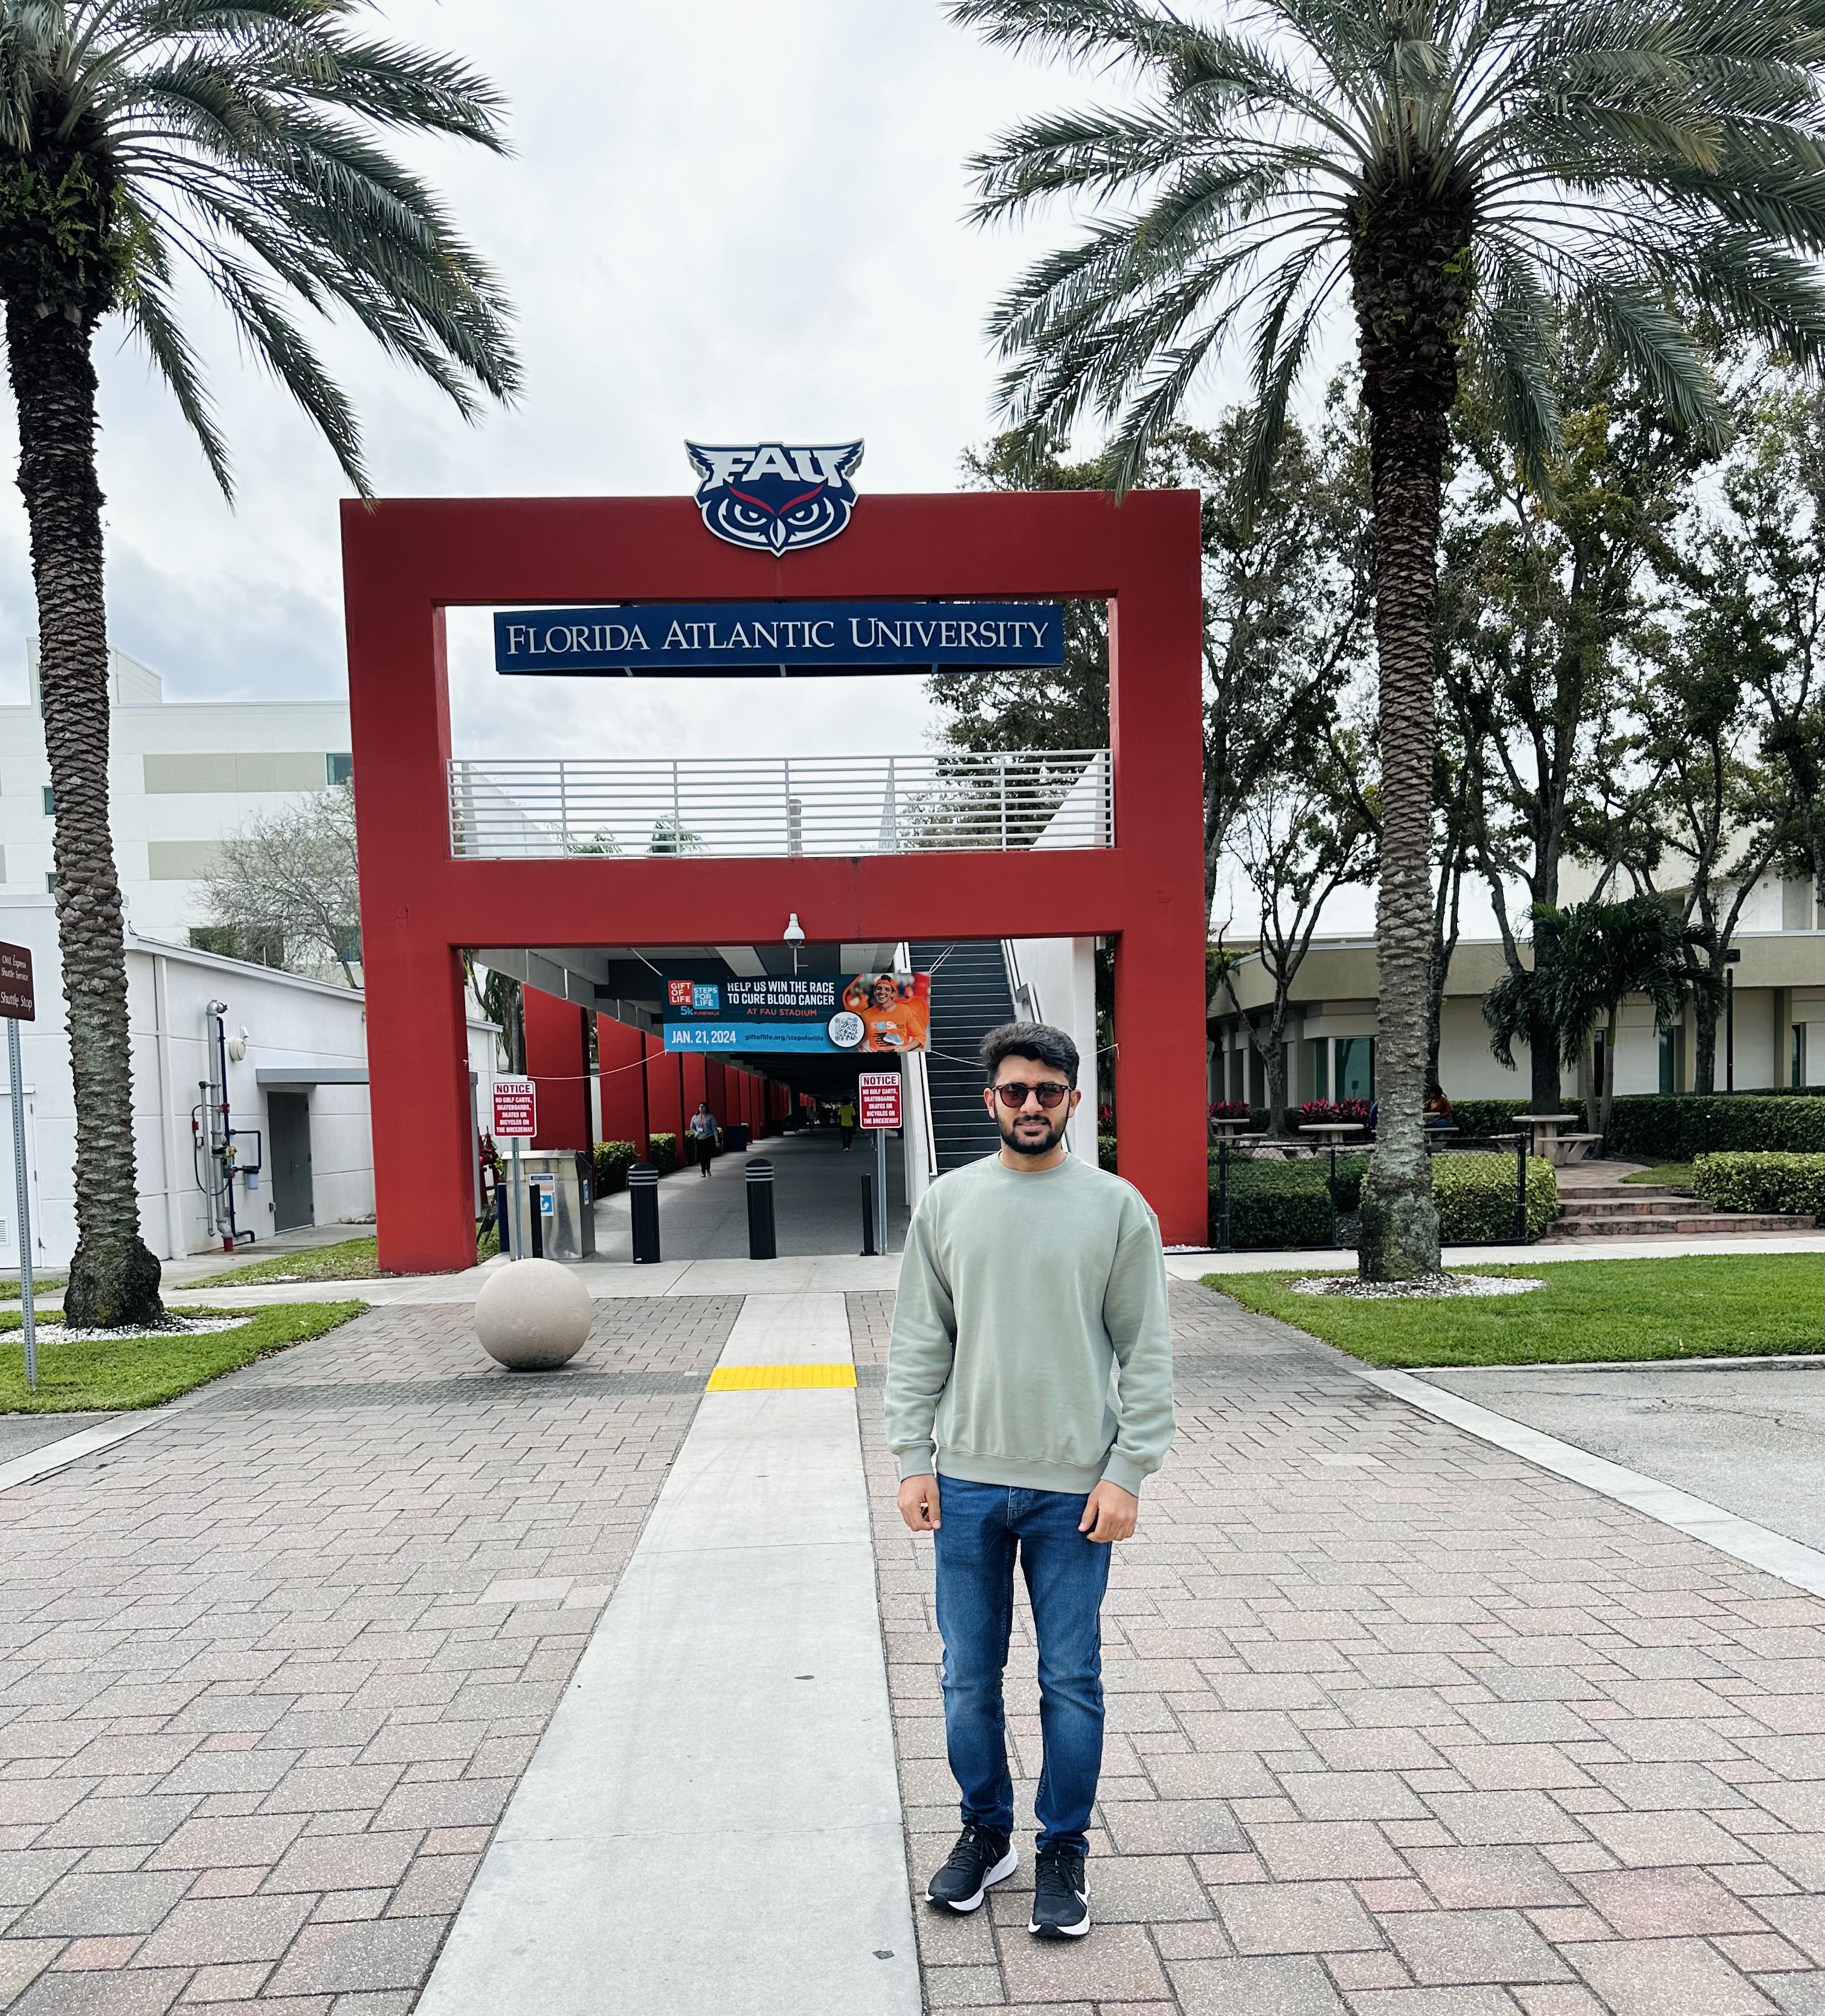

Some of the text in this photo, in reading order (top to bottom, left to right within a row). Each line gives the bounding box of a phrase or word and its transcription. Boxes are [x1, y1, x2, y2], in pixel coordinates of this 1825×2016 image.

[696, 447, 854, 492] FAU
[506, 617, 1049, 655] FLORIDA ATLANTIC UNIVERSITY
[1, 967, 29, 981] Shuttle Service
[727, 981, 835, 994] HELP US WIN THE RACE
[1, 991, 33, 1011] Shuttle Stop
[727, 994, 835, 1006] TO CURE BLOOD CANCER
[680, 1006, 694, 1016] 5k
[672, 1031, 737, 1045] JAN. 21, 2024
[863, 1076, 896, 1085] NOTICE
[496, 1085, 531, 1093] NOTICE
